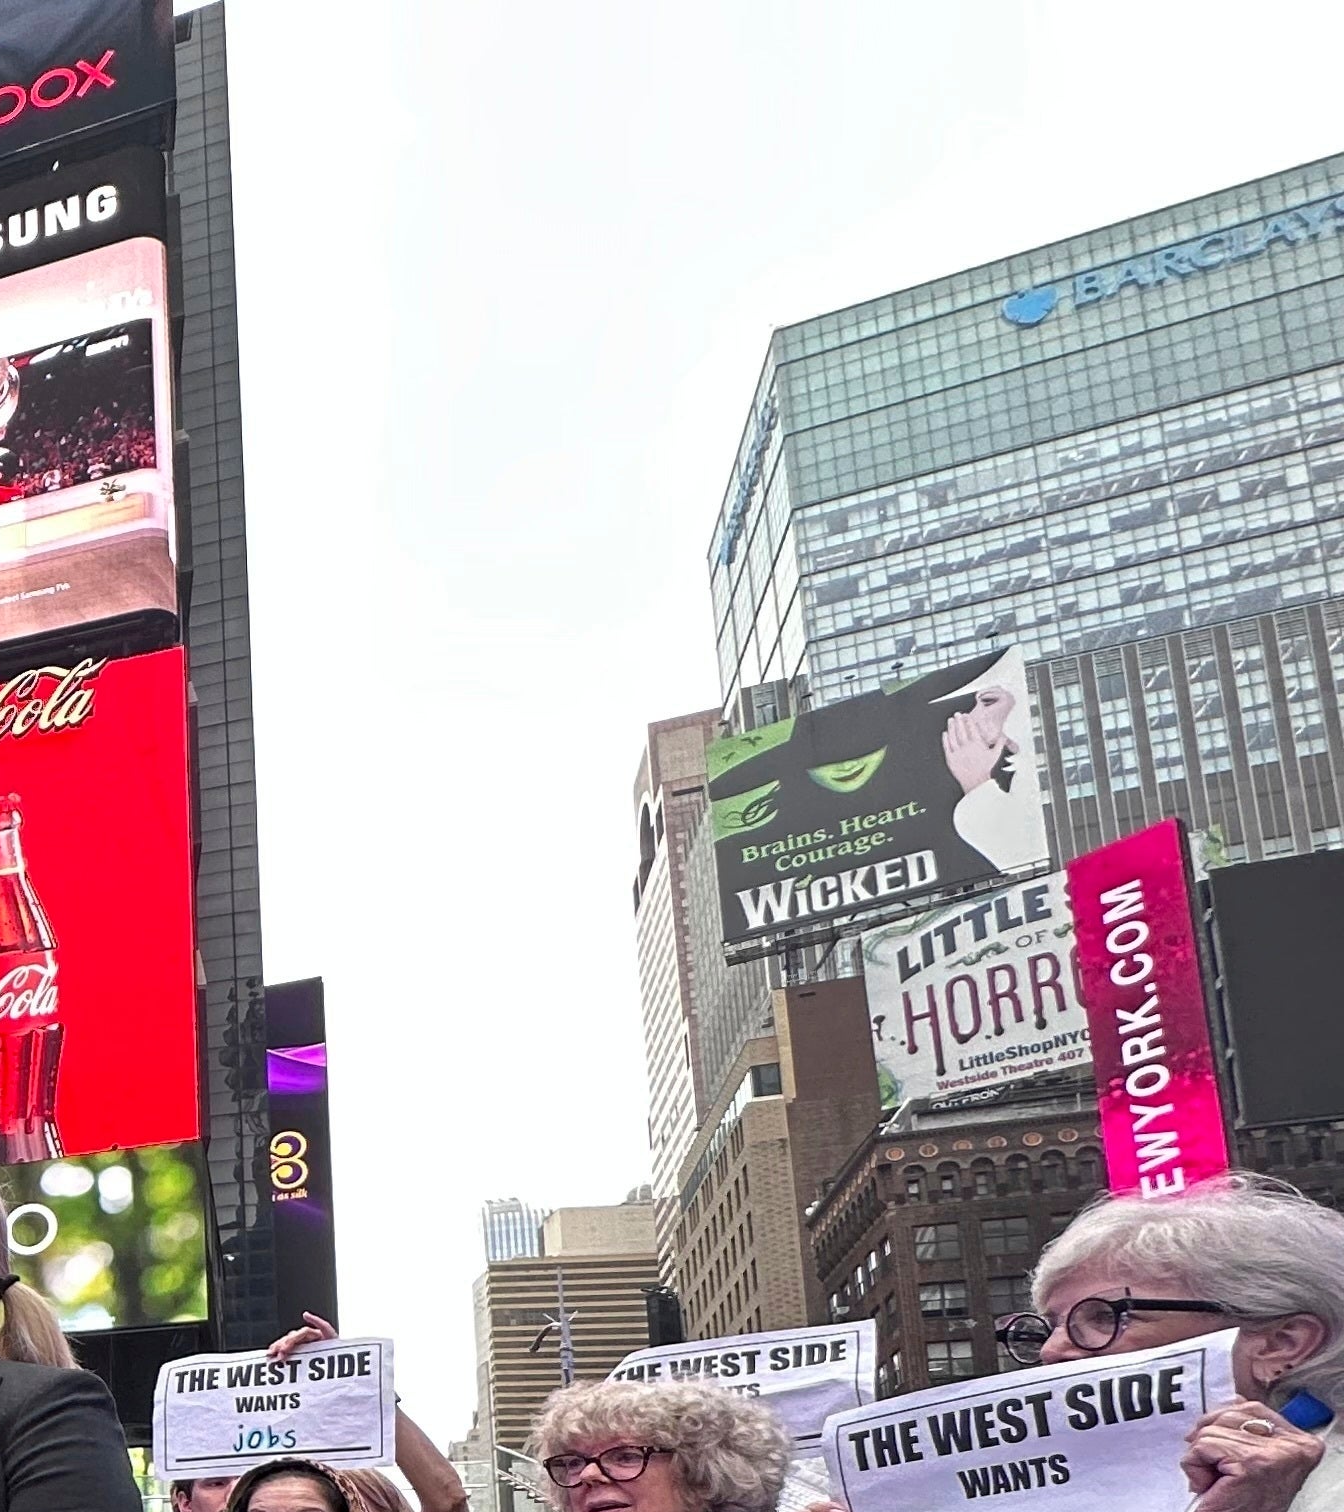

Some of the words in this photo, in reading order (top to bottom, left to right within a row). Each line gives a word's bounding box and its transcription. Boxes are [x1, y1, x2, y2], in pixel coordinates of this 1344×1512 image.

[741, 827, 834, 864] Brains.
[840, 801, 927, 836] Heart.
[774, 831, 894, 872] Courage.
[896, 883, 1053, 985] LITTLE
[1015, 929, 1049, 949] OF
[936, 1069, 999, 1091] Westside
[1002, 1056, 1054, 1076] Theatre
[1057, 1047, 1085, 1062] 407
[175, 1368, 220, 1394] THE
[226, 1358, 302, 1388] WEST
[308, 1351, 371, 1381] SIDE
[669, 1350, 761, 1380] WEST
[769, 1339, 847, 1372] SIDE
[235, 1393, 301, 1413] WANTS
[848, 1420, 924, 1472] THE
[927, 1391, 1053, 1457] WEST
[1065, 1366, 1185, 1432] SIDE
[233, 1424, 297, 1452] jobs
[957, 1454, 1070, 1500] WANTS
